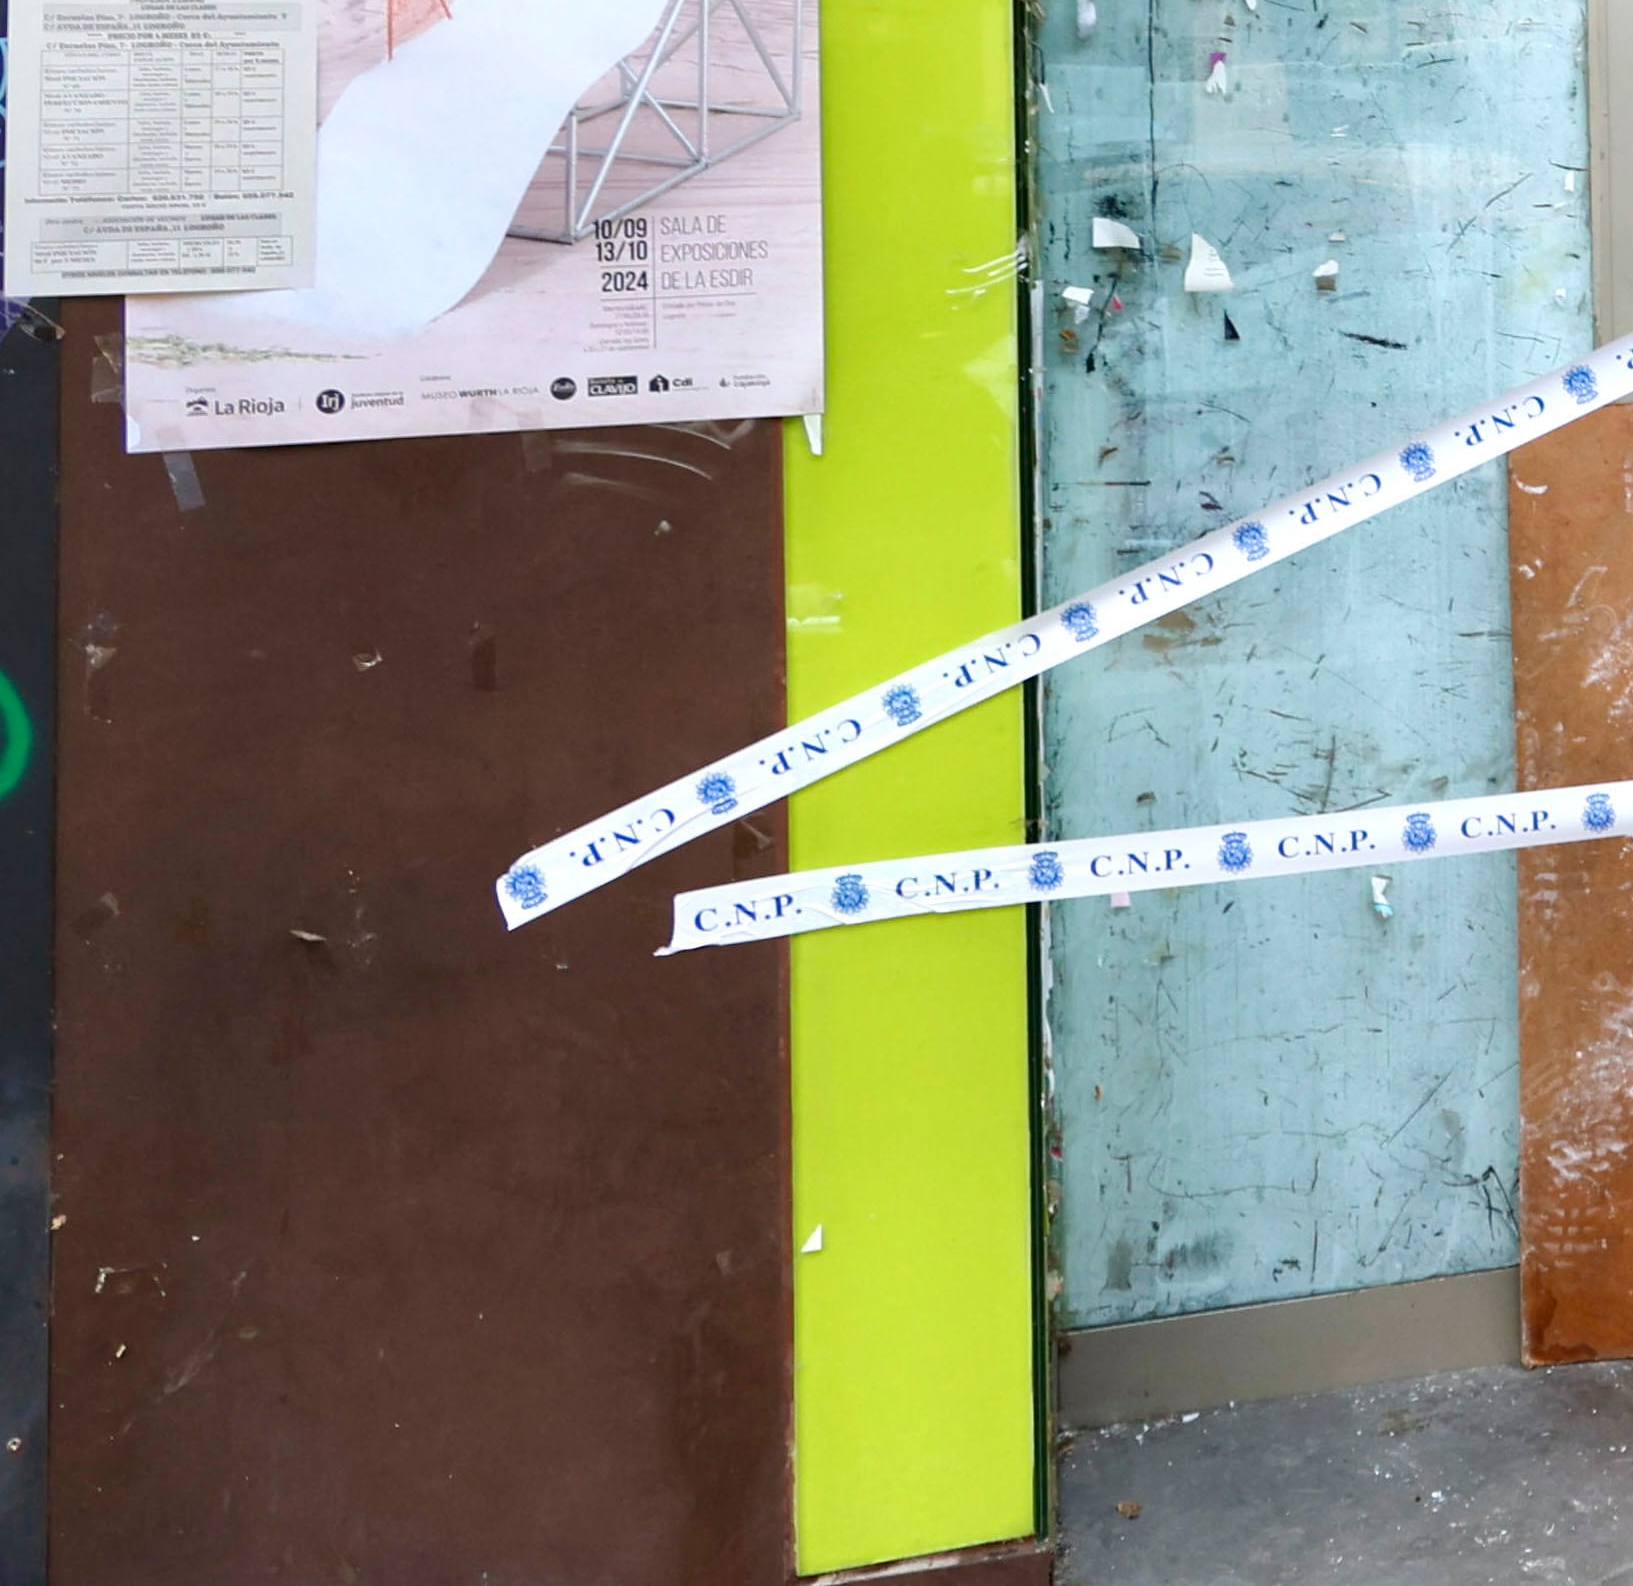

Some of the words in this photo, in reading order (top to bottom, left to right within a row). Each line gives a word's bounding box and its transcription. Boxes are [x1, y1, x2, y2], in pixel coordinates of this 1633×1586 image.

[592, 218, 648, 240] 10/09
[660, 216, 702, 235] SALA
[706, 215, 727, 234] DE
[595, 240, 648, 262] 13/10
[660, 240, 769, 263] EXPOSICIONES
[601, 271, 649, 293] 2024
[661, 271, 680, 290] DE
[684, 269, 705, 290] LA
[709, 268, 753, 288] ESDIR
[590, 383, 637, 396] CLAVIJO
[215, 399, 236, 416] La
[238, 396, 285, 416] Rioja
[351, 395, 405, 410] juventud
[1455, 395, 1546, 446] C.N.P.
[1287, 472, 1382, 525] C.N.P.
[1114, 551, 1214, 606] C.N.P.
[943, 632, 1041, 689] C.N.P.
[758, 718, 863, 776] C.N.P.
[568, 808, 682, 868] C.N.P.
[693, 893, 803, 932] C.N.P.
[895, 868, 999, 900] C.N.P.
[1089, 848, 1191, 878] C.N.P.
[1277, 829, 1376, 859] C.N.P.
[1460, 810, 1557, 839] C.N.P.
